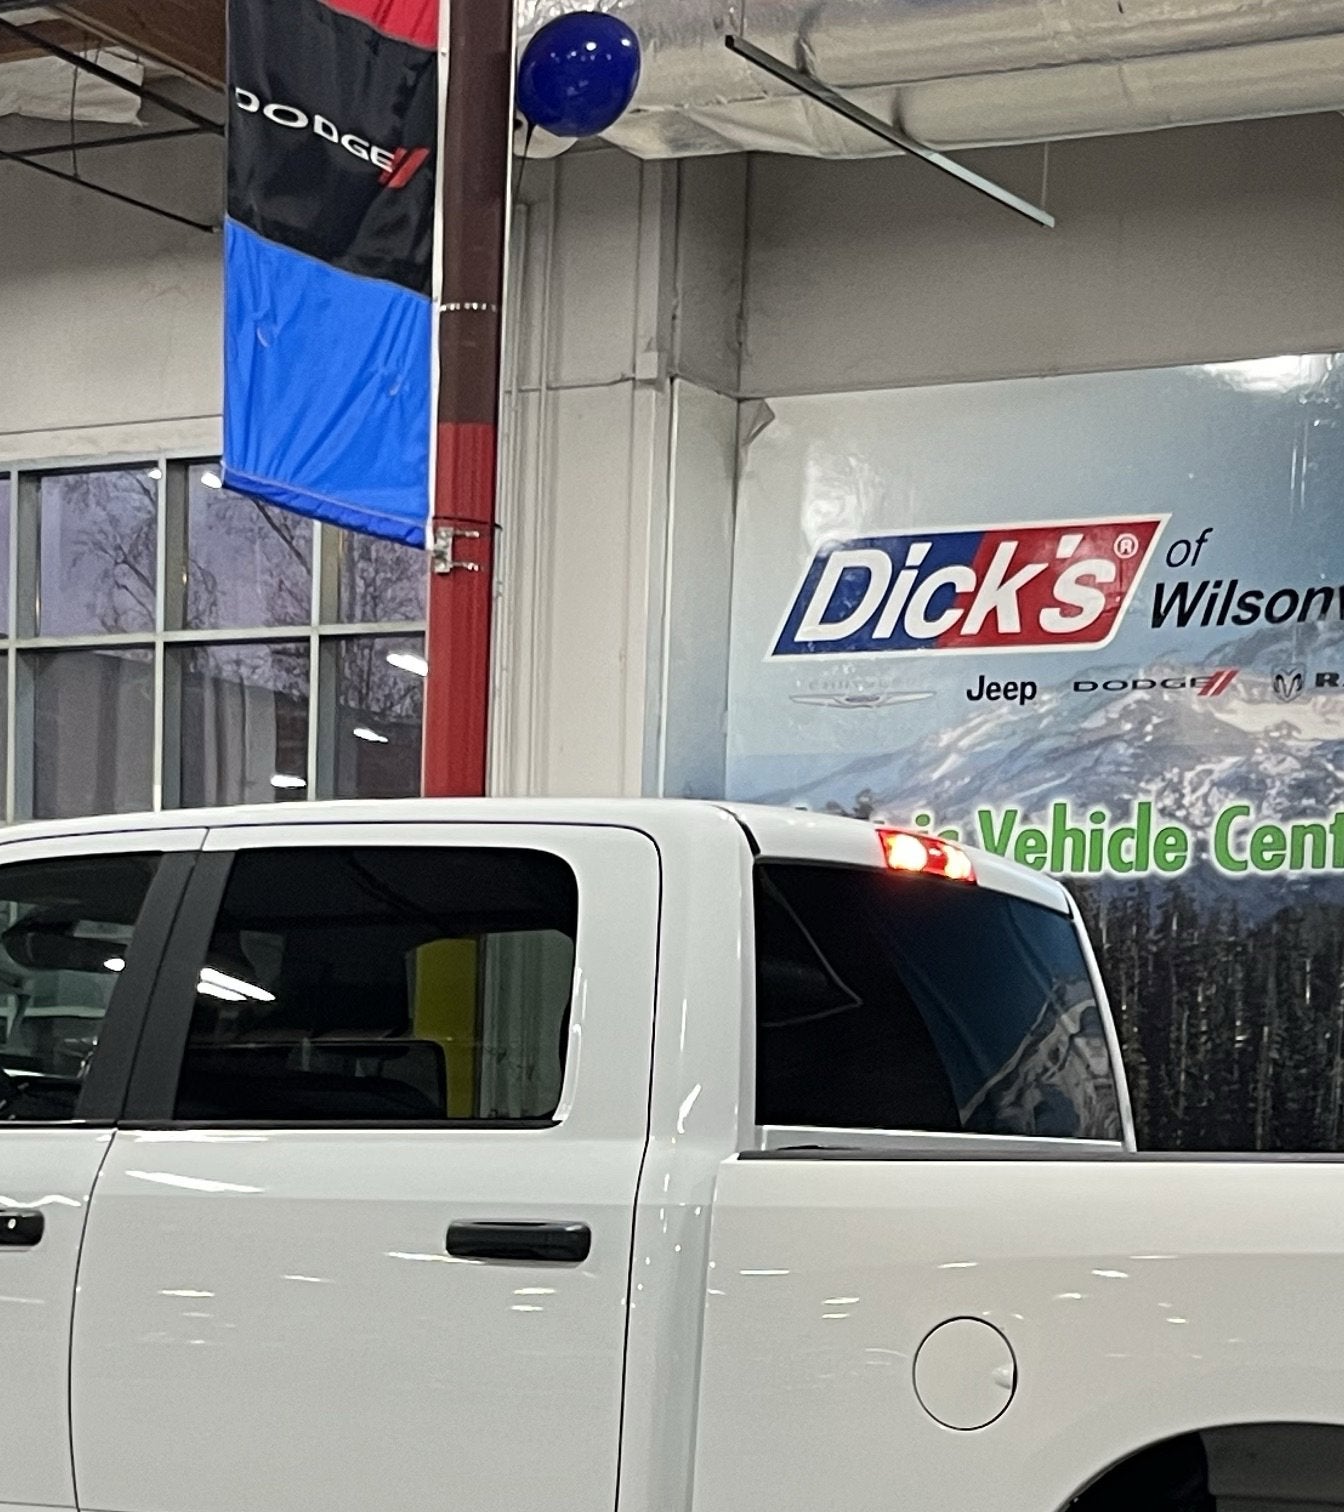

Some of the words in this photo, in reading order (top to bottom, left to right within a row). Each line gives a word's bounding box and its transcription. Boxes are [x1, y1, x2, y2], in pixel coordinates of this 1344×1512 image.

[235, 87, 395, 173] DODGE
[1165, 528, 1213, 568] of
[967, 675, 1038, 705] Jeep
[1072, 677, 1209, 692] DODGE
[977, 802, 1189, 872] Vehicle
